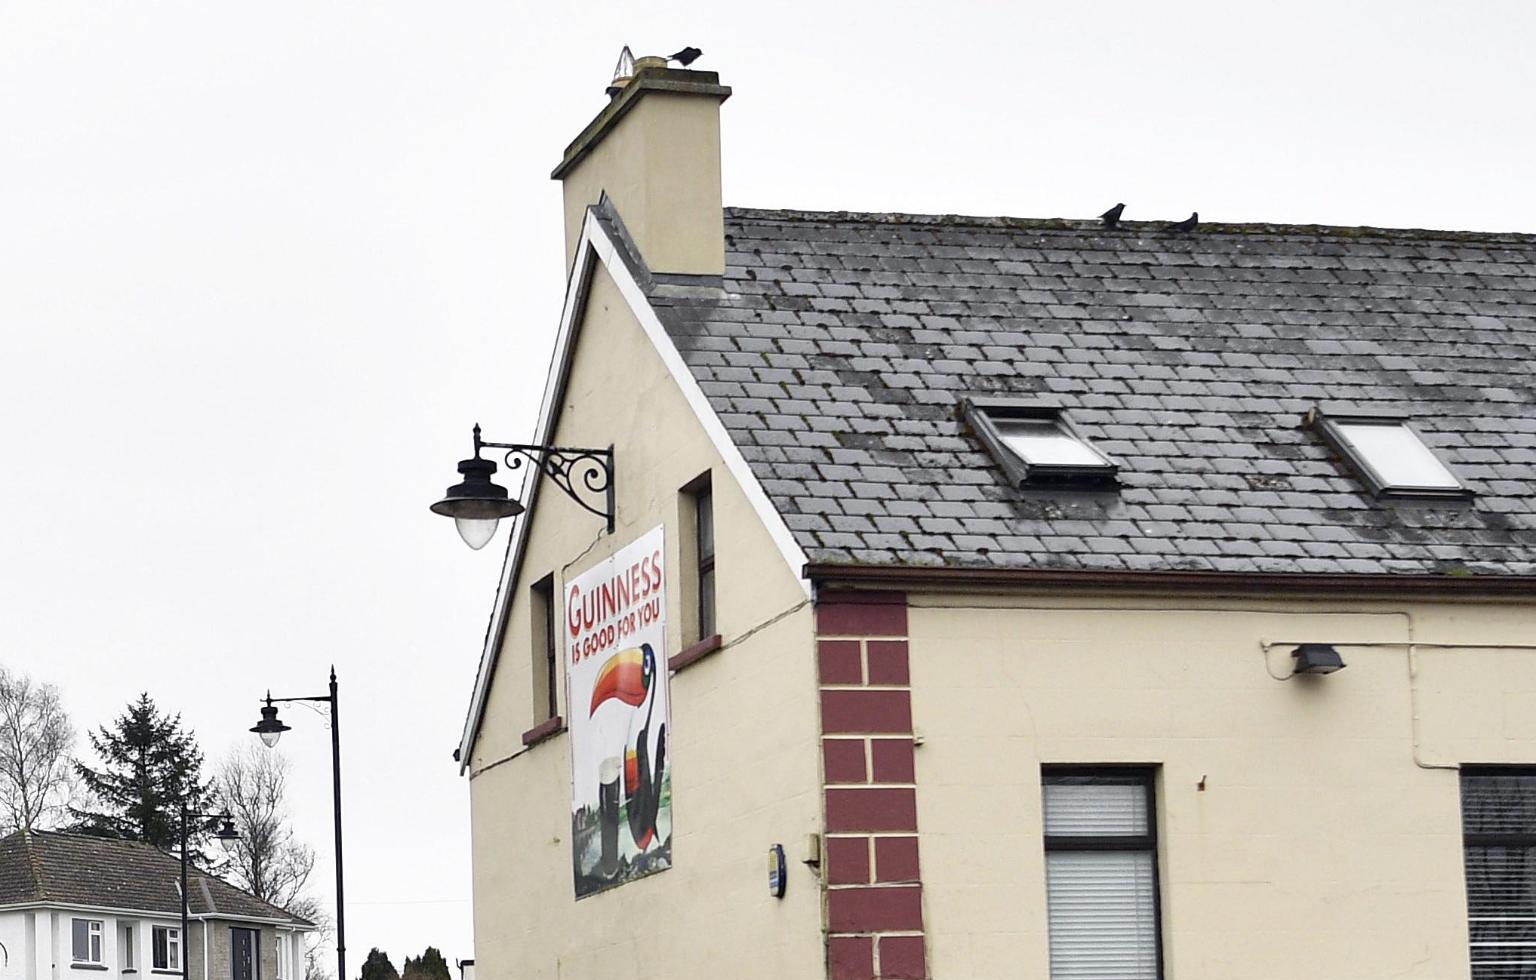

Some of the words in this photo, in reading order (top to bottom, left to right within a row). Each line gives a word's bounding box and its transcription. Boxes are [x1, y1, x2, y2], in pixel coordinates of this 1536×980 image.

[569, 550, 661, 636] GUINNESS
[572, 642, 580, 664] IS
[583, 625, 615, 657] GOOD
[618, 612, 635, 639] FOR
[638, 597, 660, 630] YOU
